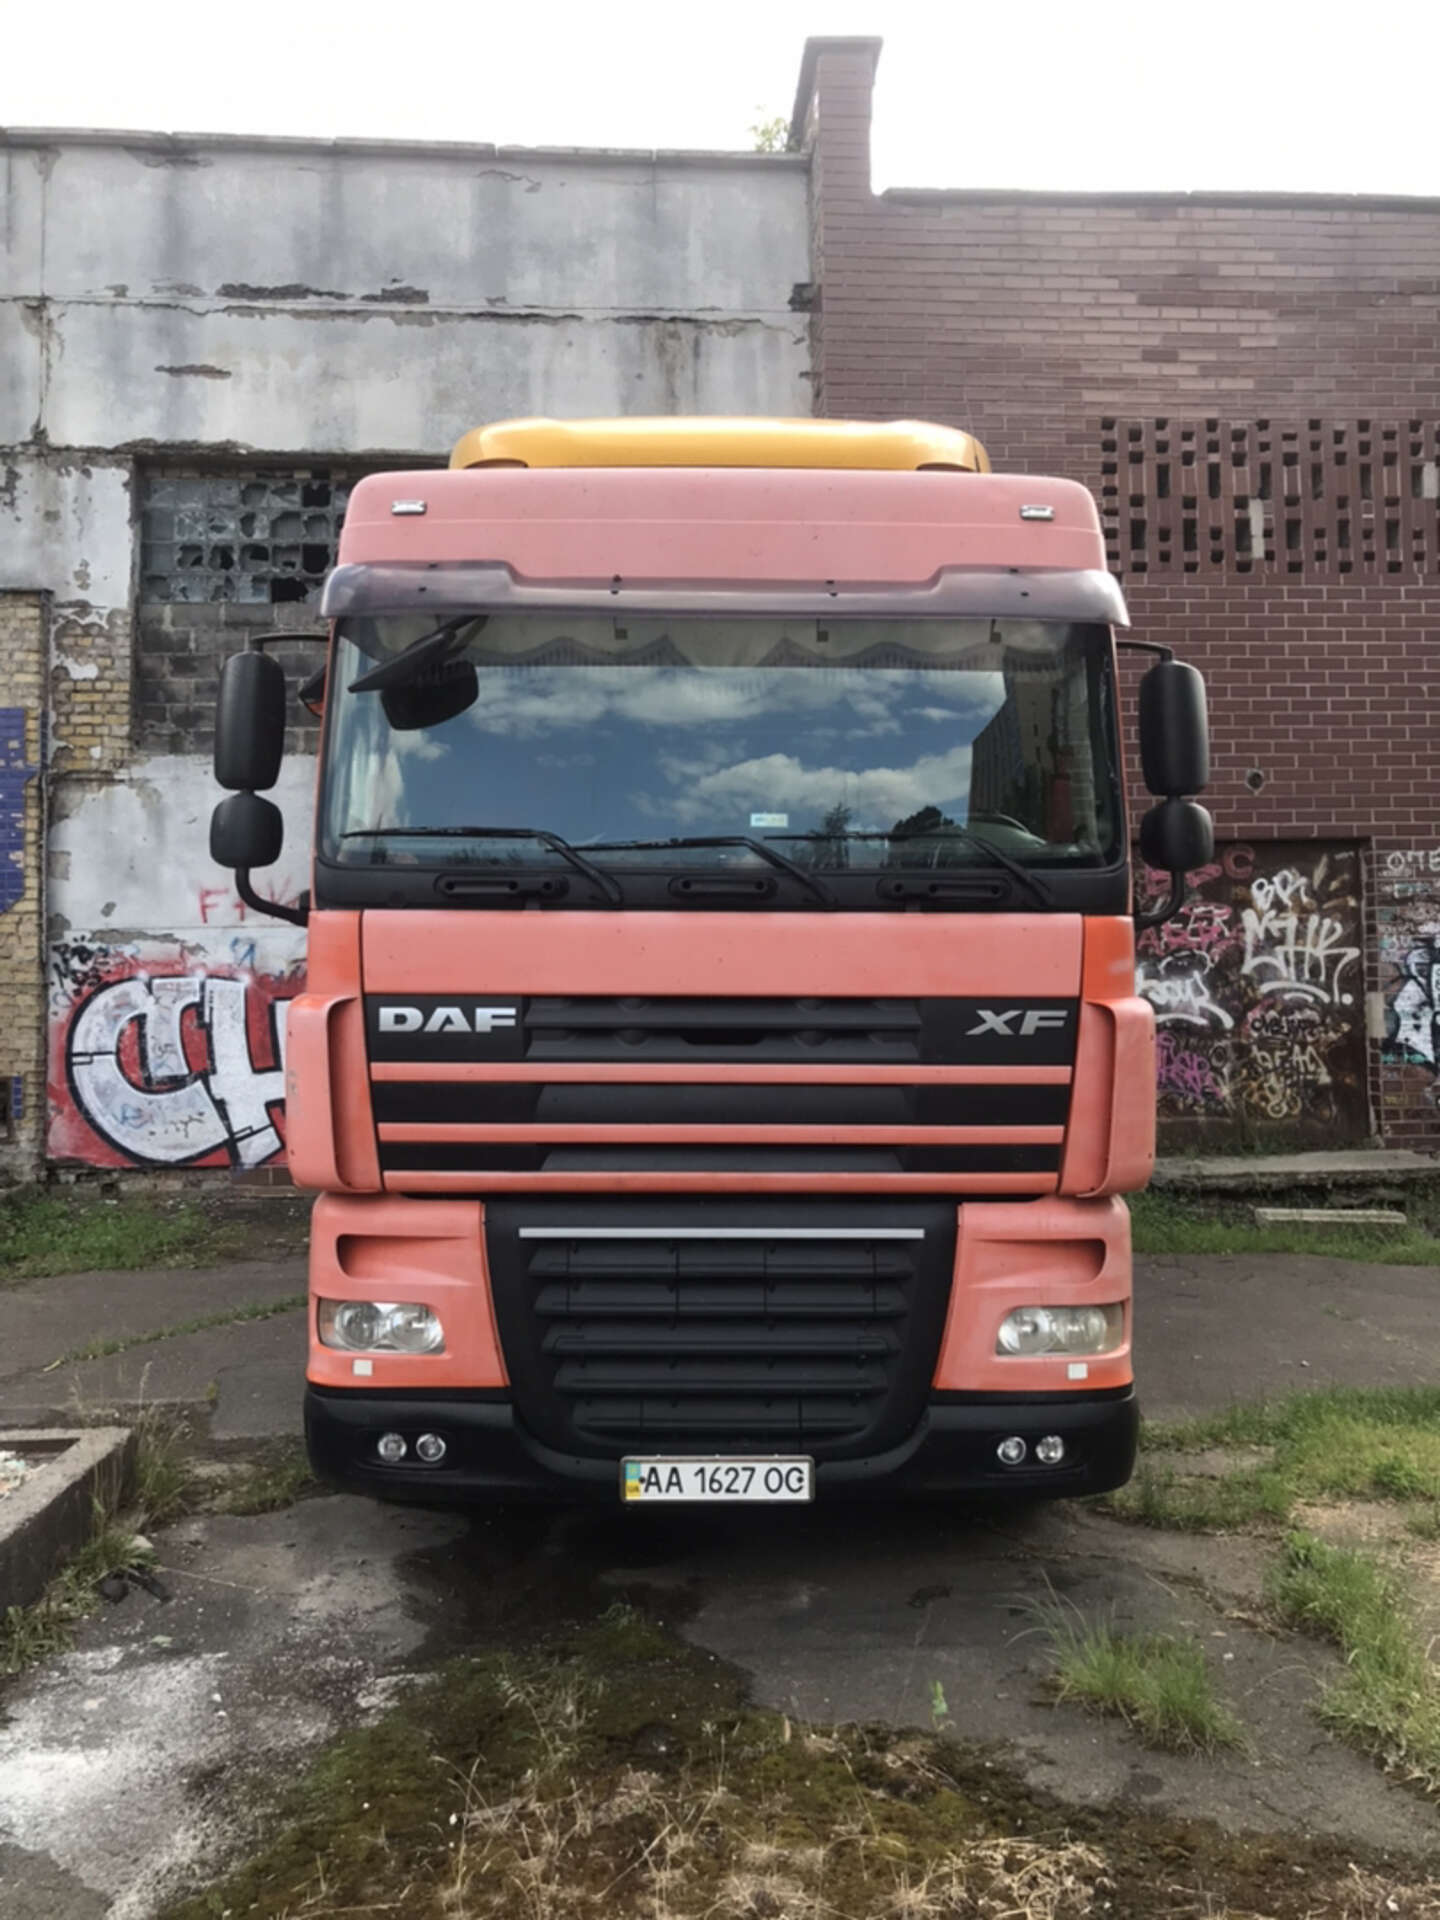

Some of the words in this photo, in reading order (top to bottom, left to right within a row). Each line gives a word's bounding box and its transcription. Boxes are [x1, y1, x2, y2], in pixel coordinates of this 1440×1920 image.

[378, 1006, 516, 1033] DAF
[964, 1009, 1068, 1035] XF
[643, 1466, 684, 1494] AA
[693, 1466, 757, 1494] 1627
[763, 1466, 805, 1494] OC
